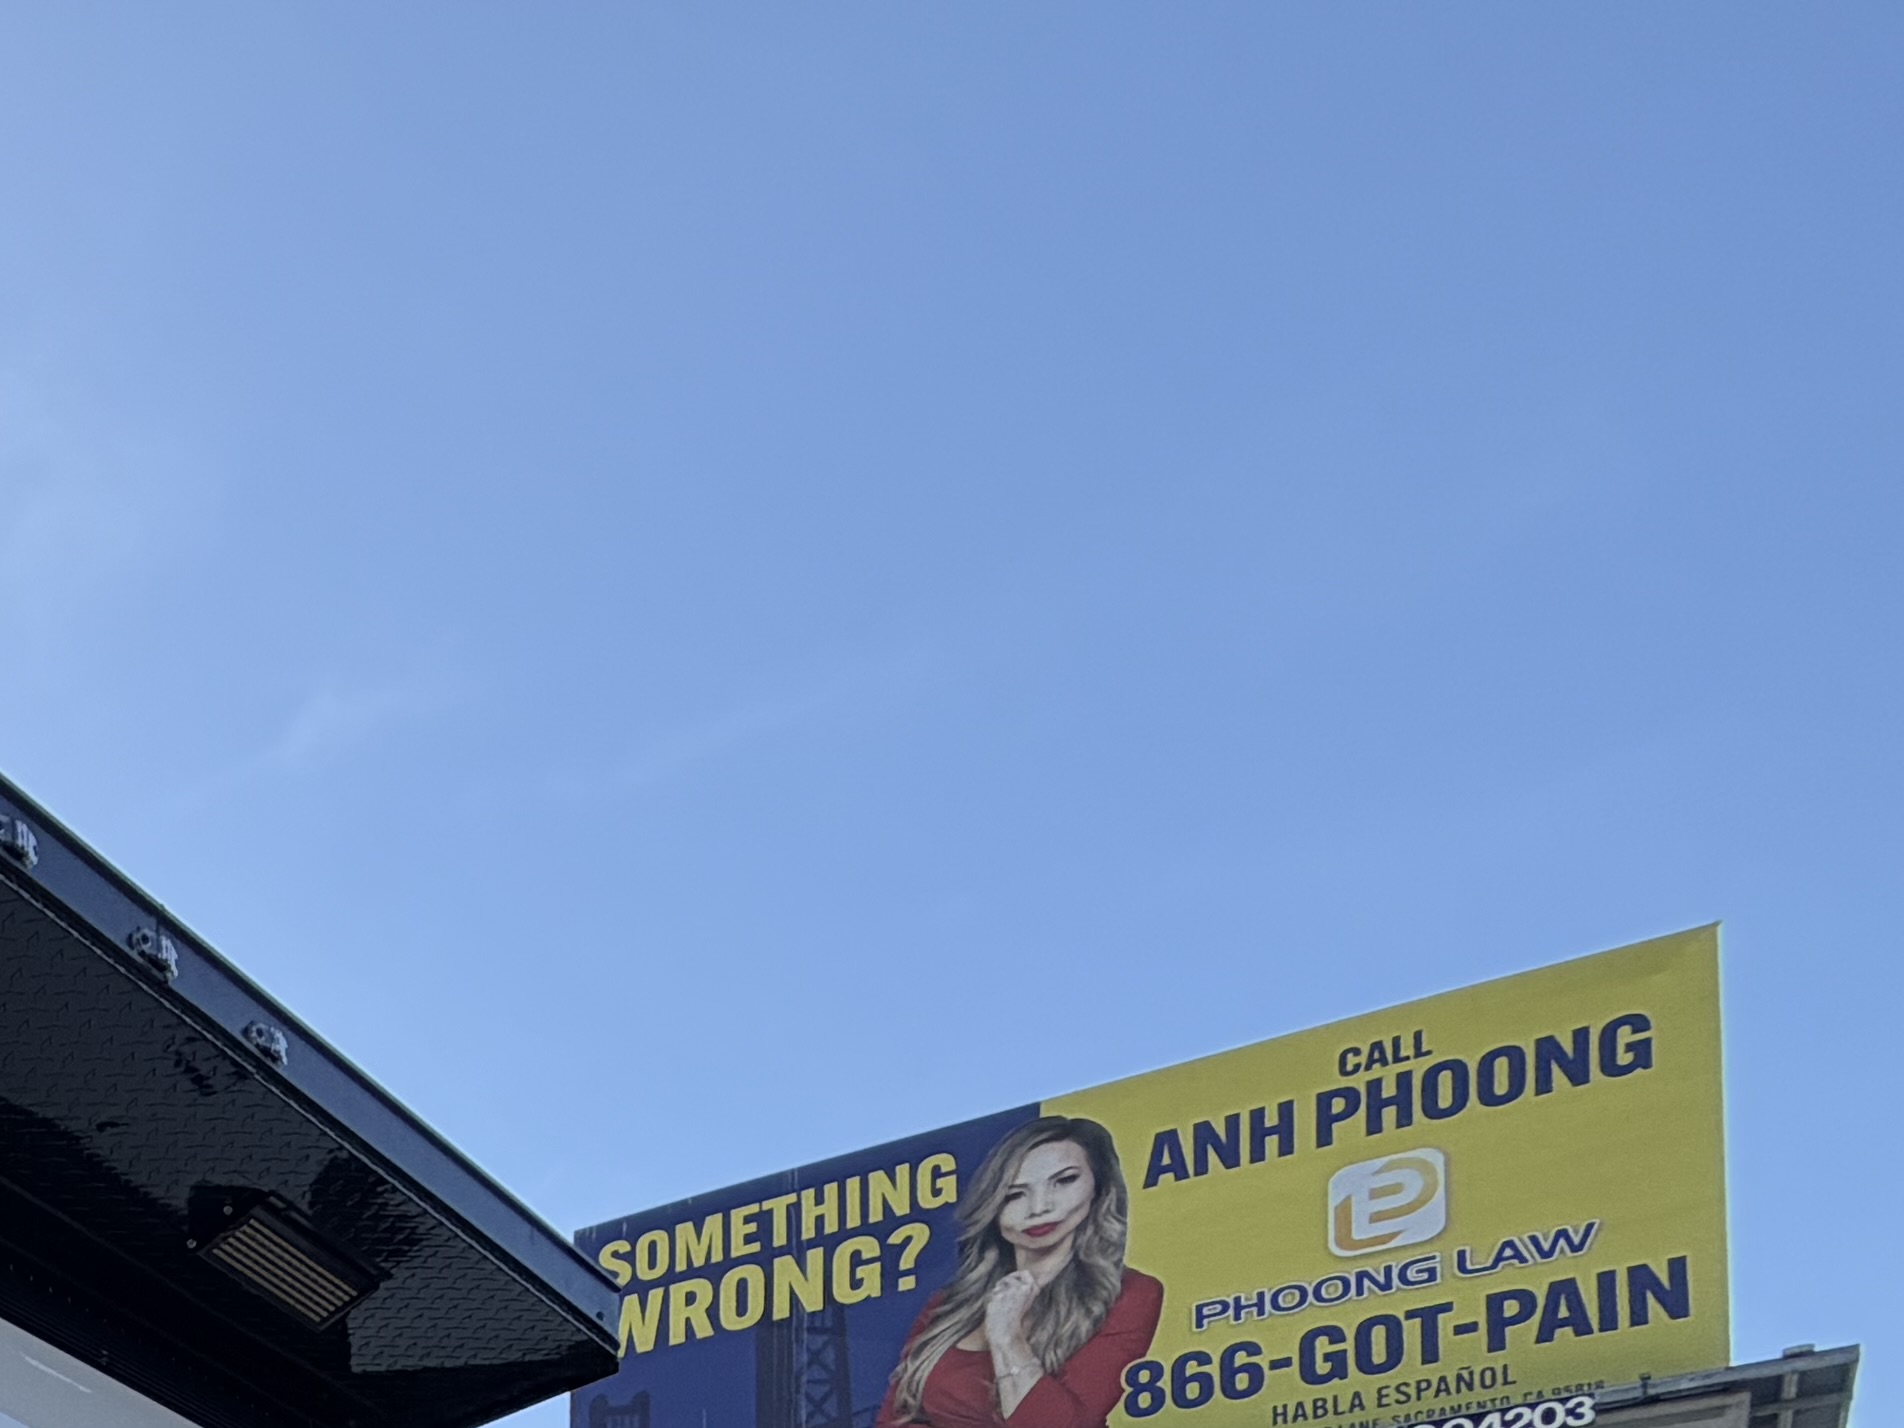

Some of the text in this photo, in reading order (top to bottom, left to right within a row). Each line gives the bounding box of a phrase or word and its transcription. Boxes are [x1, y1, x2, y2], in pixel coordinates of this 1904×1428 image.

[1142, 1012, 1653, 1189] ANH PHOONG
[1338, 1030, 1433, 1076] CALL
[599, 1152, 957, 1286] SOMETHING
[1194, 1220, 1599, 1330] PHOONG LAW
[619, 1222, 930, 1358] WRONG?
[1123, 1255, 1690, 1418] 866-GOT-PAIN
[1271, 1363, 1517, 1426] HABLA ESPAÑOL
